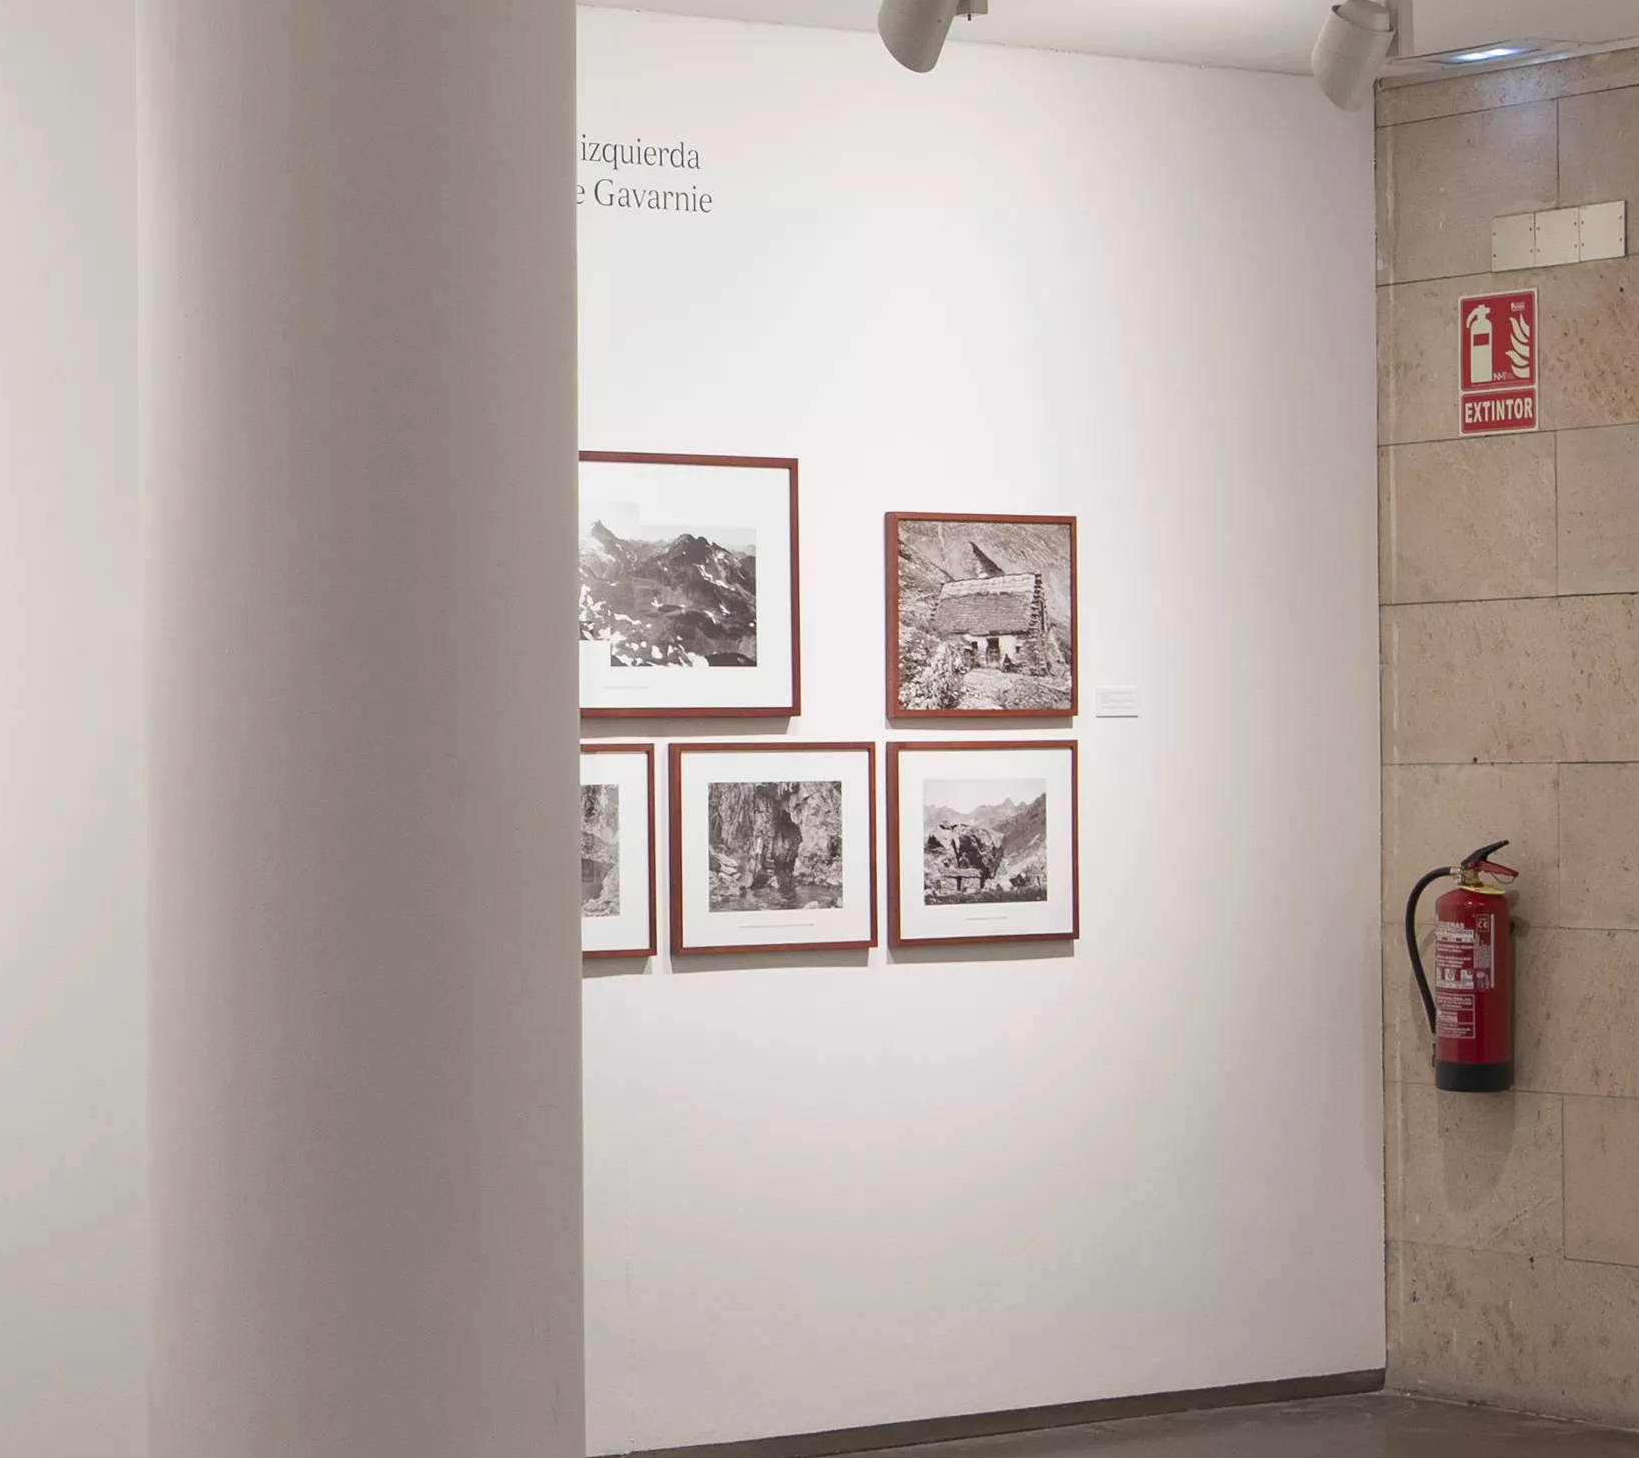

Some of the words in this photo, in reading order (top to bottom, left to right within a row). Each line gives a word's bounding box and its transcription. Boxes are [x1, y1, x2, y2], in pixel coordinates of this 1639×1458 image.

[580, 133, 702, 171] izquierda
[593, 177, 714, 214] Gavarnie
[1464, 396, 1533, 424] EXTINTOR
